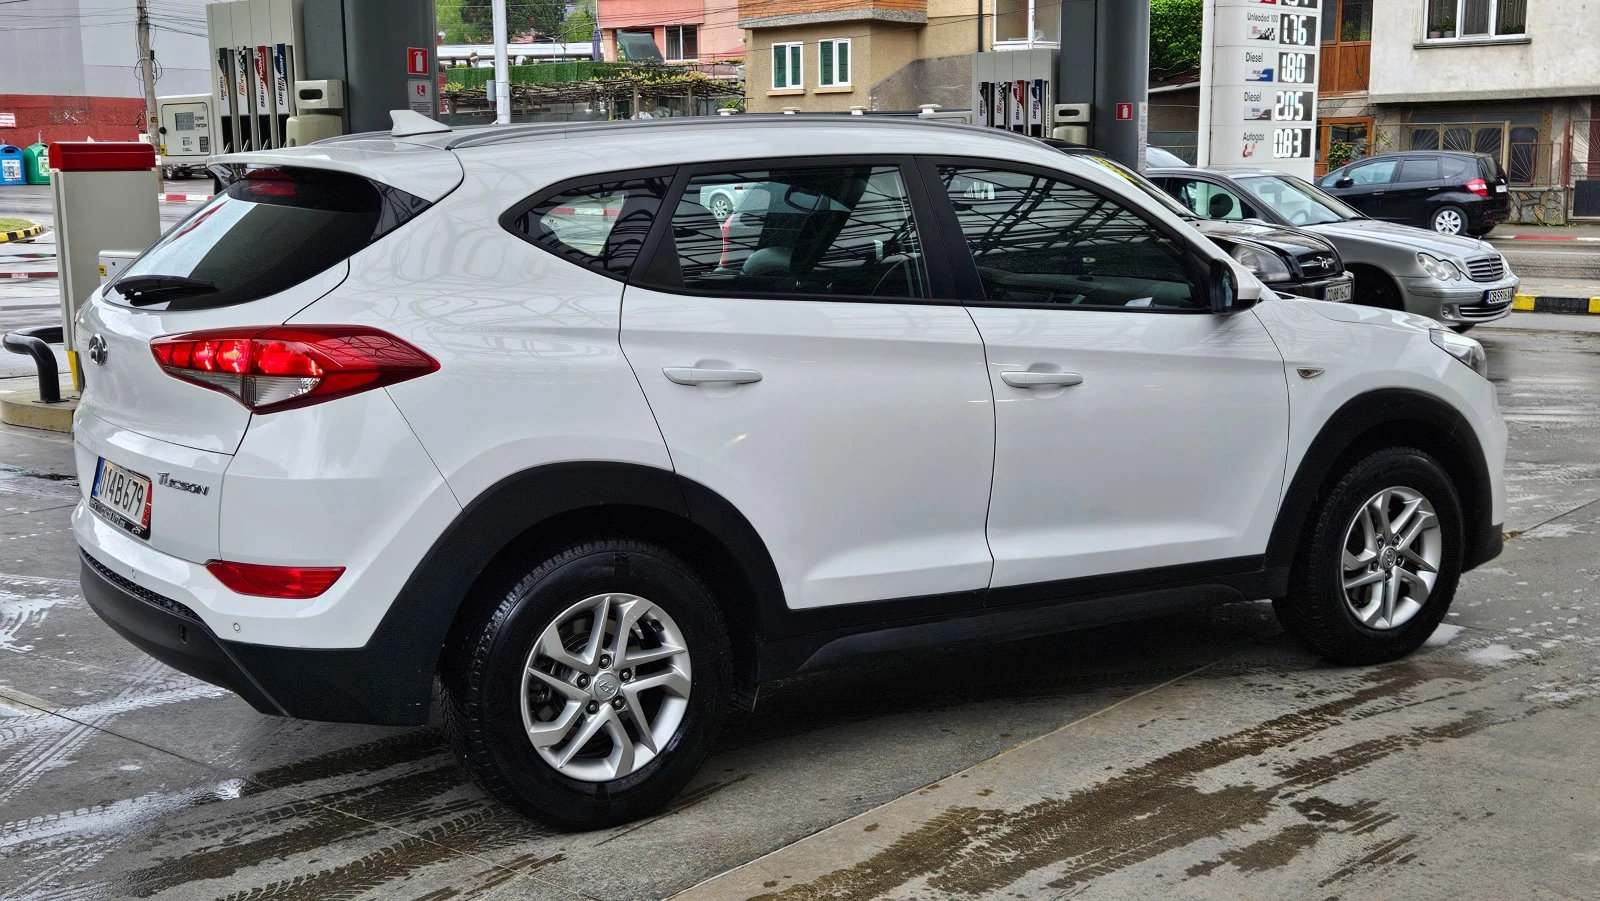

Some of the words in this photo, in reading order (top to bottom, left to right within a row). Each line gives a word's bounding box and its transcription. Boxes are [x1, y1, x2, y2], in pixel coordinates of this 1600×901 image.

[1247, 12, 1269, 22] Unleaded
[1245, 52, 1263, 62] Diesel
[1244, 91, 1261, 102] Diesel
[1243, 132, 1265, 143] Autogas
